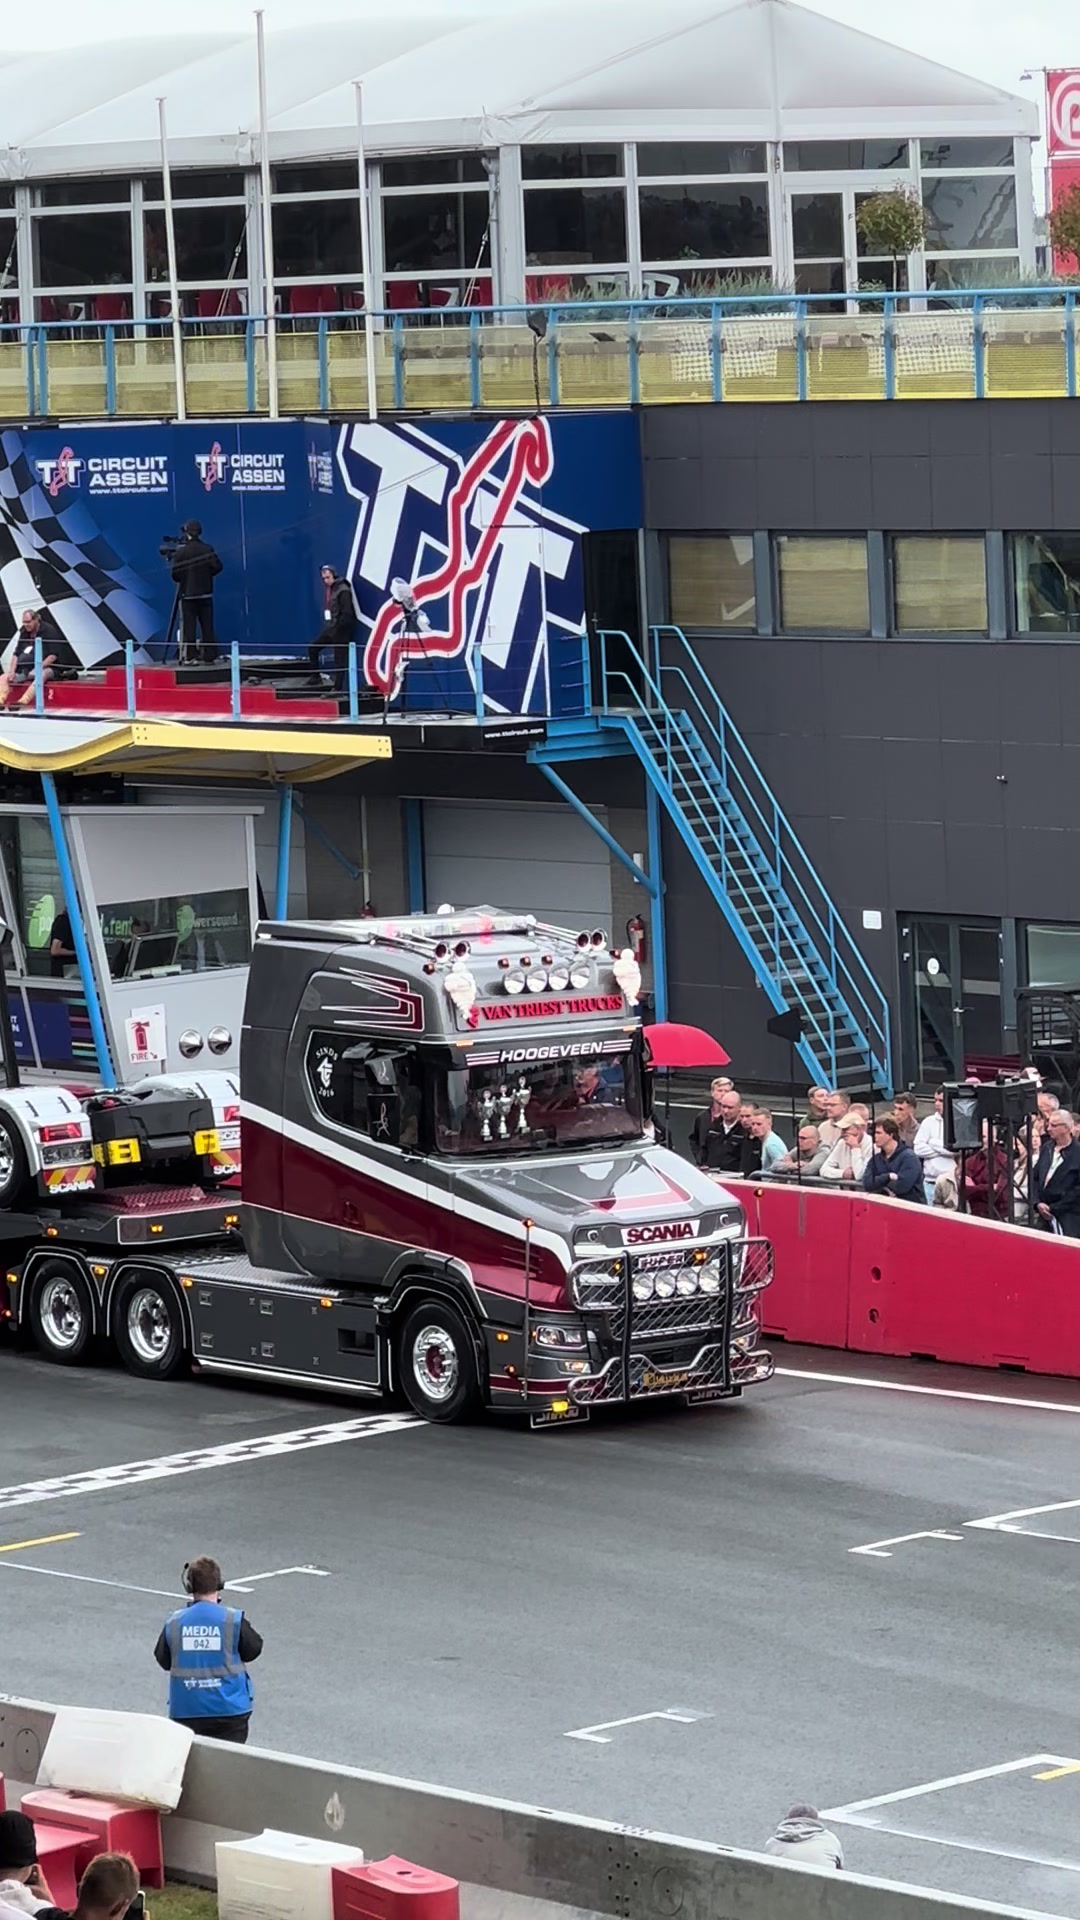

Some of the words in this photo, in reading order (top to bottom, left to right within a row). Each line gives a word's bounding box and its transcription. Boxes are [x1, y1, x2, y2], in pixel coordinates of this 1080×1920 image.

[87, 456, 168, 471] CIRCUIT
[230, 454, 285, 468] CIRCUIT
[89, 471, 168, 487] ASSEN
[231, 469, 285, 483] ASSEN
[481, 1004, 512, 1021] VAN
[513, 1000, 565, 1018] TRIEST
[564, 995, 622, 1013] TRUCKS
[131, 1052, 149, 1061] FIRE
[500, 1041, 604, 1063] HOOGEVEEN
[49, 1179, 96, 1194] SCANIA
[626, 1222, 694, 1244] SCANIA
[640, 1254, 685, 1268] SUPER
[182, 1626, 221, 1636] MEDIA
[193, 1638, 210, 1649] 042
